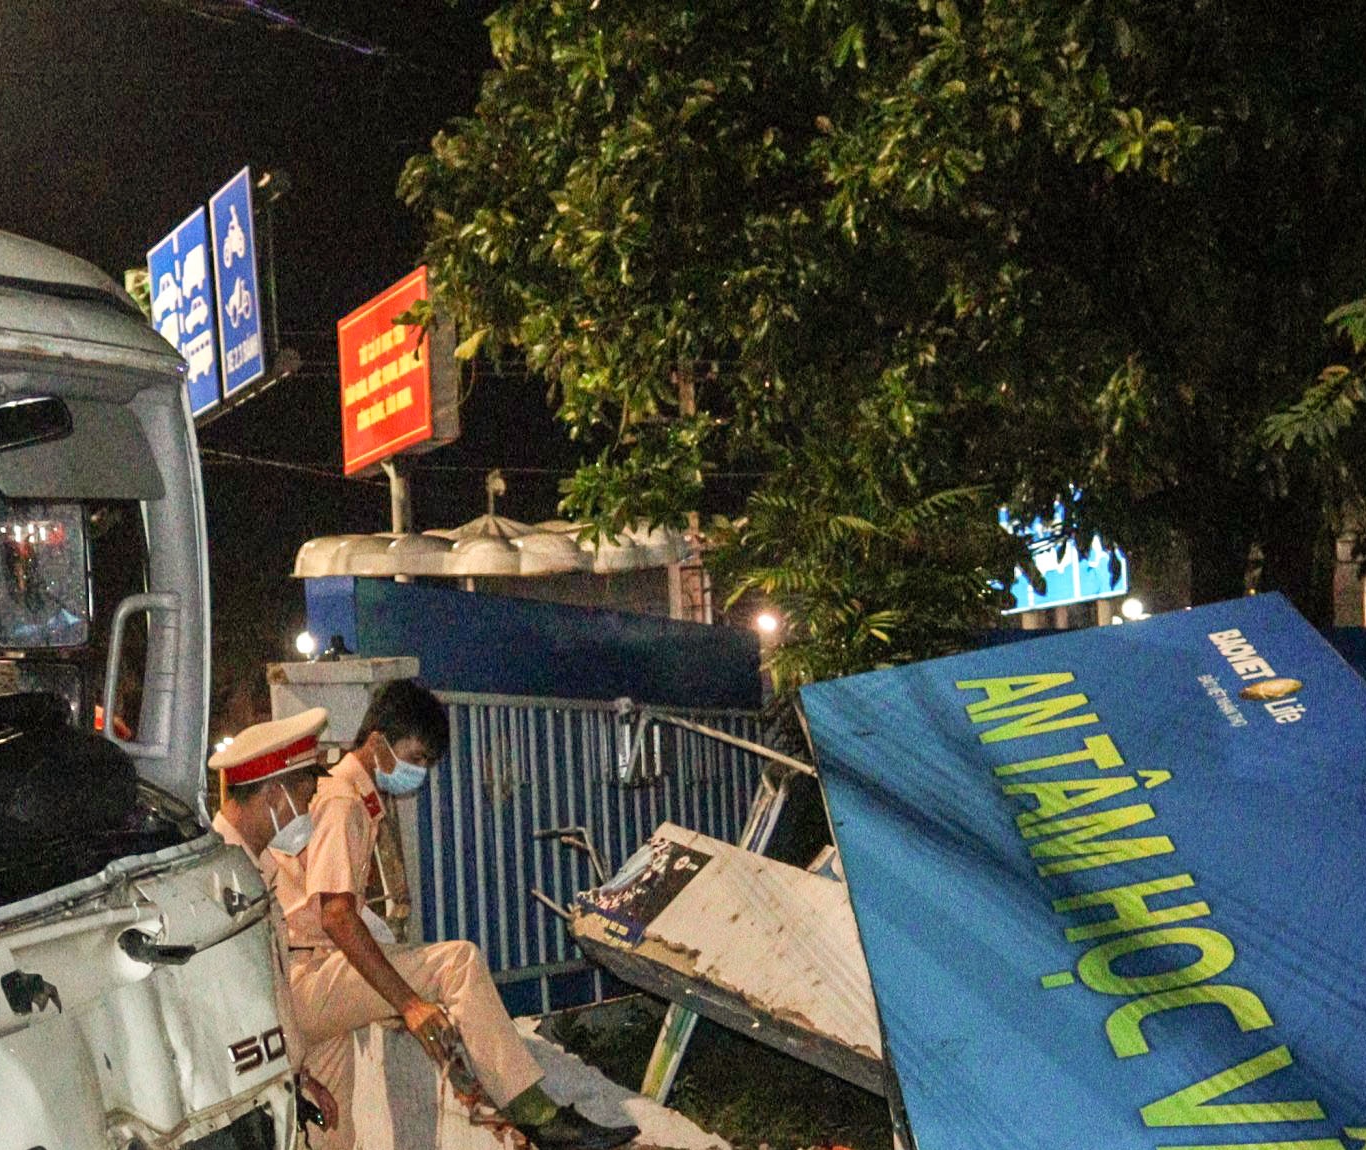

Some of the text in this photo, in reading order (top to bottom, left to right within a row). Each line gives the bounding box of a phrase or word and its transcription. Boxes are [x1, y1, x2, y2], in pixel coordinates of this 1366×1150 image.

[955, 672, 1099, 744] AN
[1263, 697, 1307, 724] Life
[994, 733, 1175, 877] TÂM
[1040, 873, 1275, 1058] HỌC
